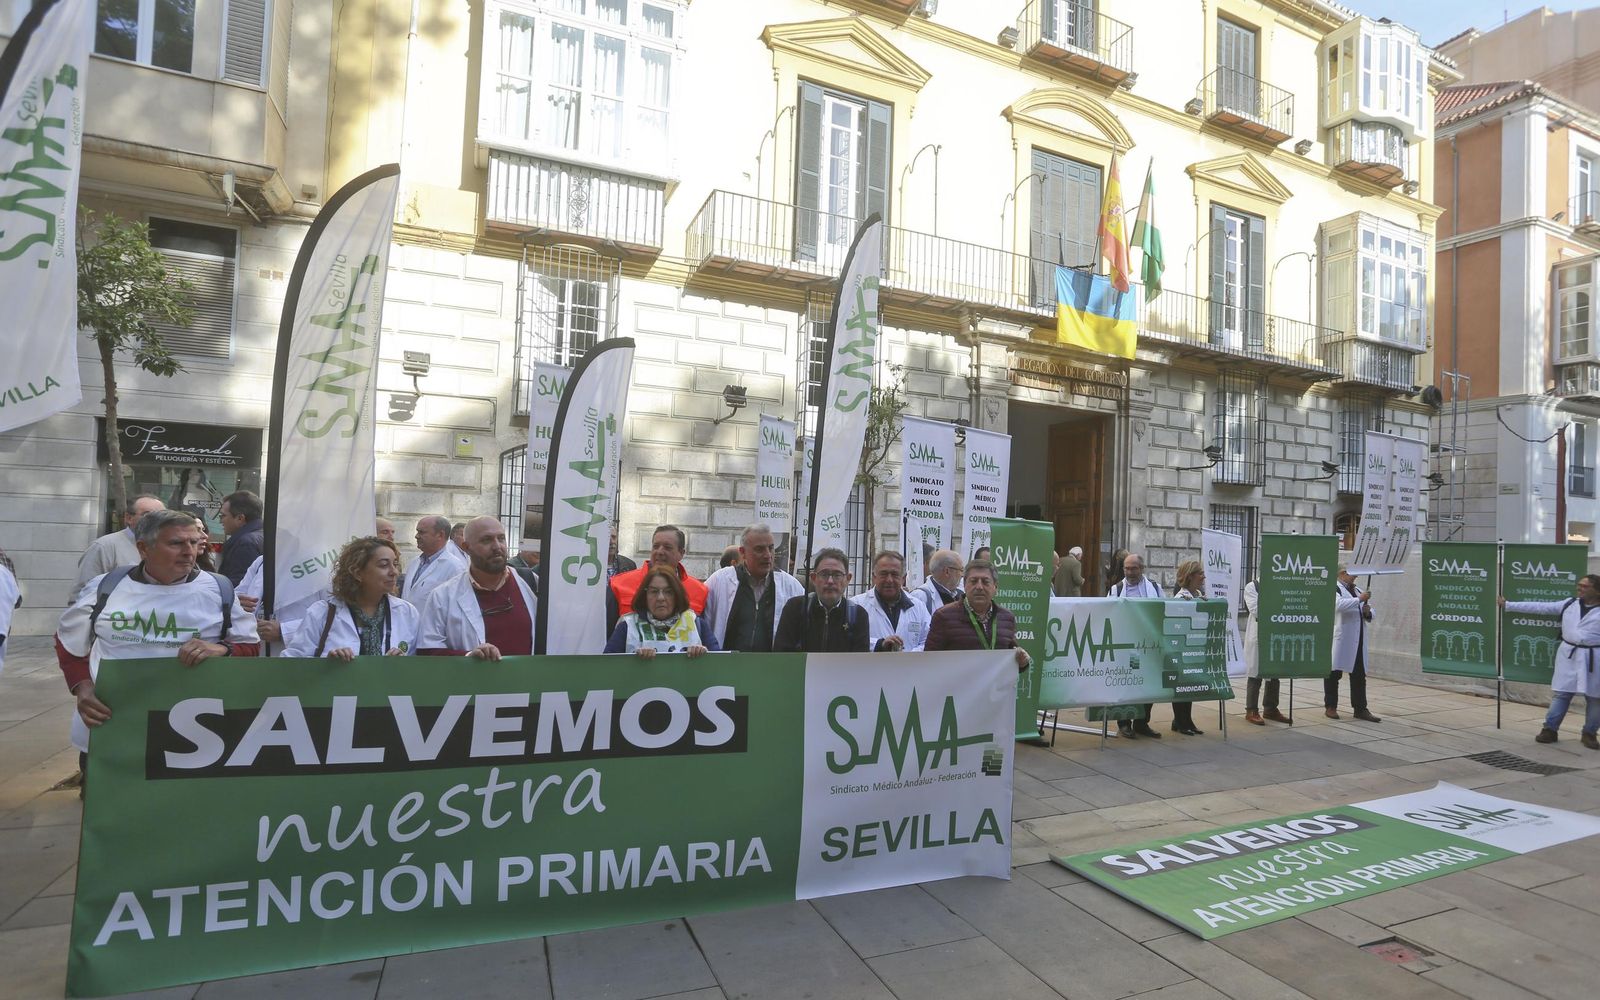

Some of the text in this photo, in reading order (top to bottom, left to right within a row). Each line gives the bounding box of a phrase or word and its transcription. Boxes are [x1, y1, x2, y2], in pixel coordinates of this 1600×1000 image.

[328, 254, 347, 310] Sevilla
[296, 267, 371, 439] SMA
[538, 374, 565, 401] SM
[124, 425, 237, 456] Fernando
[584, 406, 600, 459] Sevilla
[155, 454, 198, 464] PELUQUERÍA
[206, 456, 237, 466] ESTÉTICA
[909, 442, 943, 463] SMA
[971, 452, 999, 472] SMA
[909, 476, 944, 487] SINDICATO
[914, 486, 940, 497] MÉDICO
[971, 483, 1000, 494] SINDICATO
[911, 498, 942, 508] ANDALUZ
[972, 504, 997, 513] ANDALUZ
[969, 514, 991, 524] CÓRD
[994, 545, 1041, 570] SMA
[1272, 553, 1326, 575] SMA
[1429, 558, 1485, 574] SMA
[1511, 561, 1572, 578] SMA
[995, 589, 1038, 599] SINDICATO
[1434, 584, 1483, 593] SINDICATO
[1440, 593, 1477, 601] MÉDICO
[1516, 588, 1571, 597] SINDICATO
[1437, 602, 1481, 610] ANDALUZ
[110, 608, 198, 639] SMA
[1270, 613, 1319, 623] CÓRDOBA
[1430, 613, 1483, 624] CÓRDOBA
[1044, 612, 1135, 668] SMA
[1041, 667, 1133, 679] Sindicato Médico Andaluz
[1105, 675, 1144, 687] Córdoba
[1176, 685, 1209, 693] SINDICATO
[164, 685, 737, 771] SALVEMOS
[826, 685, 994, 782] SMA
[830, 784, 869, 795] Sindicato
[872, 780, 903, 791] Médico
[903, 776, 934, 788] Andaluz
[938, 770, 977, 783] Federación
[256, 766, 607, 863] nuestra
[1404, 803, 1518, 830] SMA
[821, 808, 1004, 862] SEVILLA
[1100, 814, 1360, 875] SALVEMOS
[1208, 839, 1359, 890] nuestra
[92, 836, 772, 946] ATENCIÓN PRIMARIA
[1191, 845, 1490, 928] ATENCIÓN PRIMARIA
